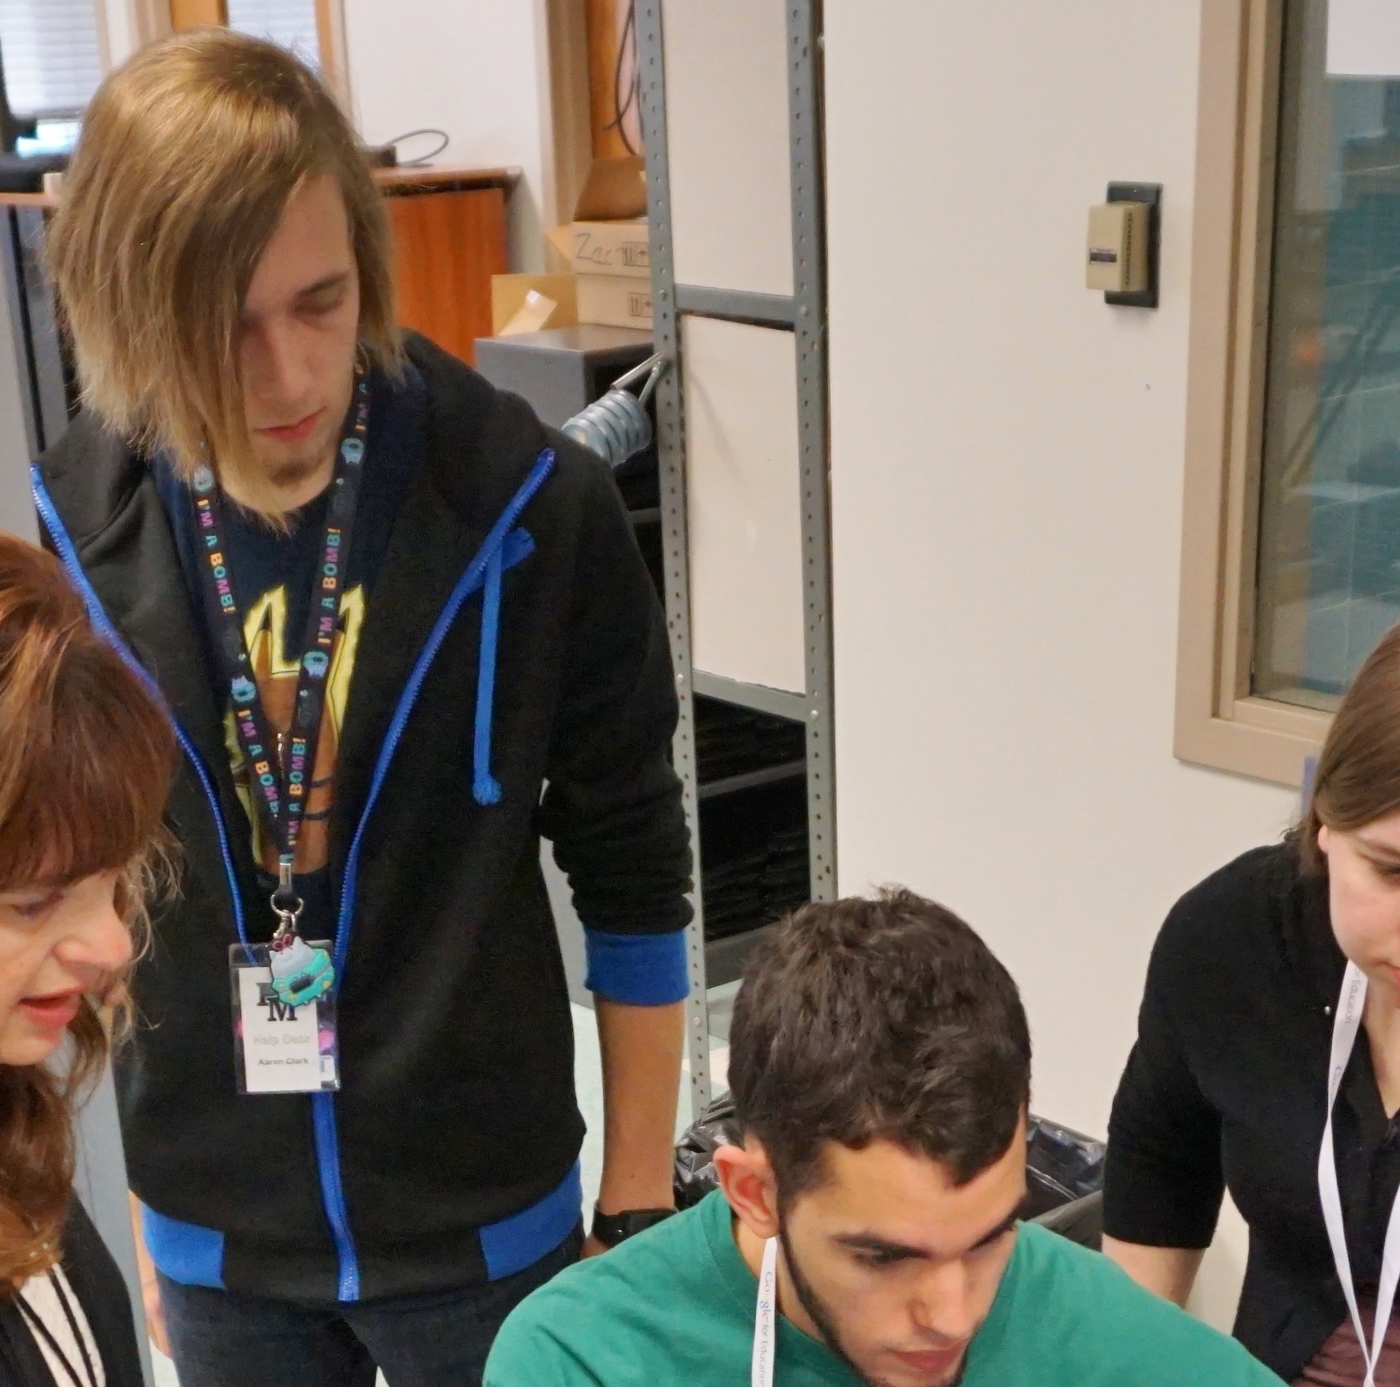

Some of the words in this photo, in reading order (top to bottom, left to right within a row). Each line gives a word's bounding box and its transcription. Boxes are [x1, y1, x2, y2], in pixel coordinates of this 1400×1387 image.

[197, 498, 215, 528] I'M
[205, 534, 218, 547] A
[321, 527, 341, 590] BOMB!
[209, 552, 237, 614] BOMB!
[321, 596, 335, 609] A
[317, 616, 334, 645] I'M
[288, 737, 307, 796] BOMB!
[258, 1058, 284, 1066] Aaron
[286, 1057, 309, 1065] Clark
